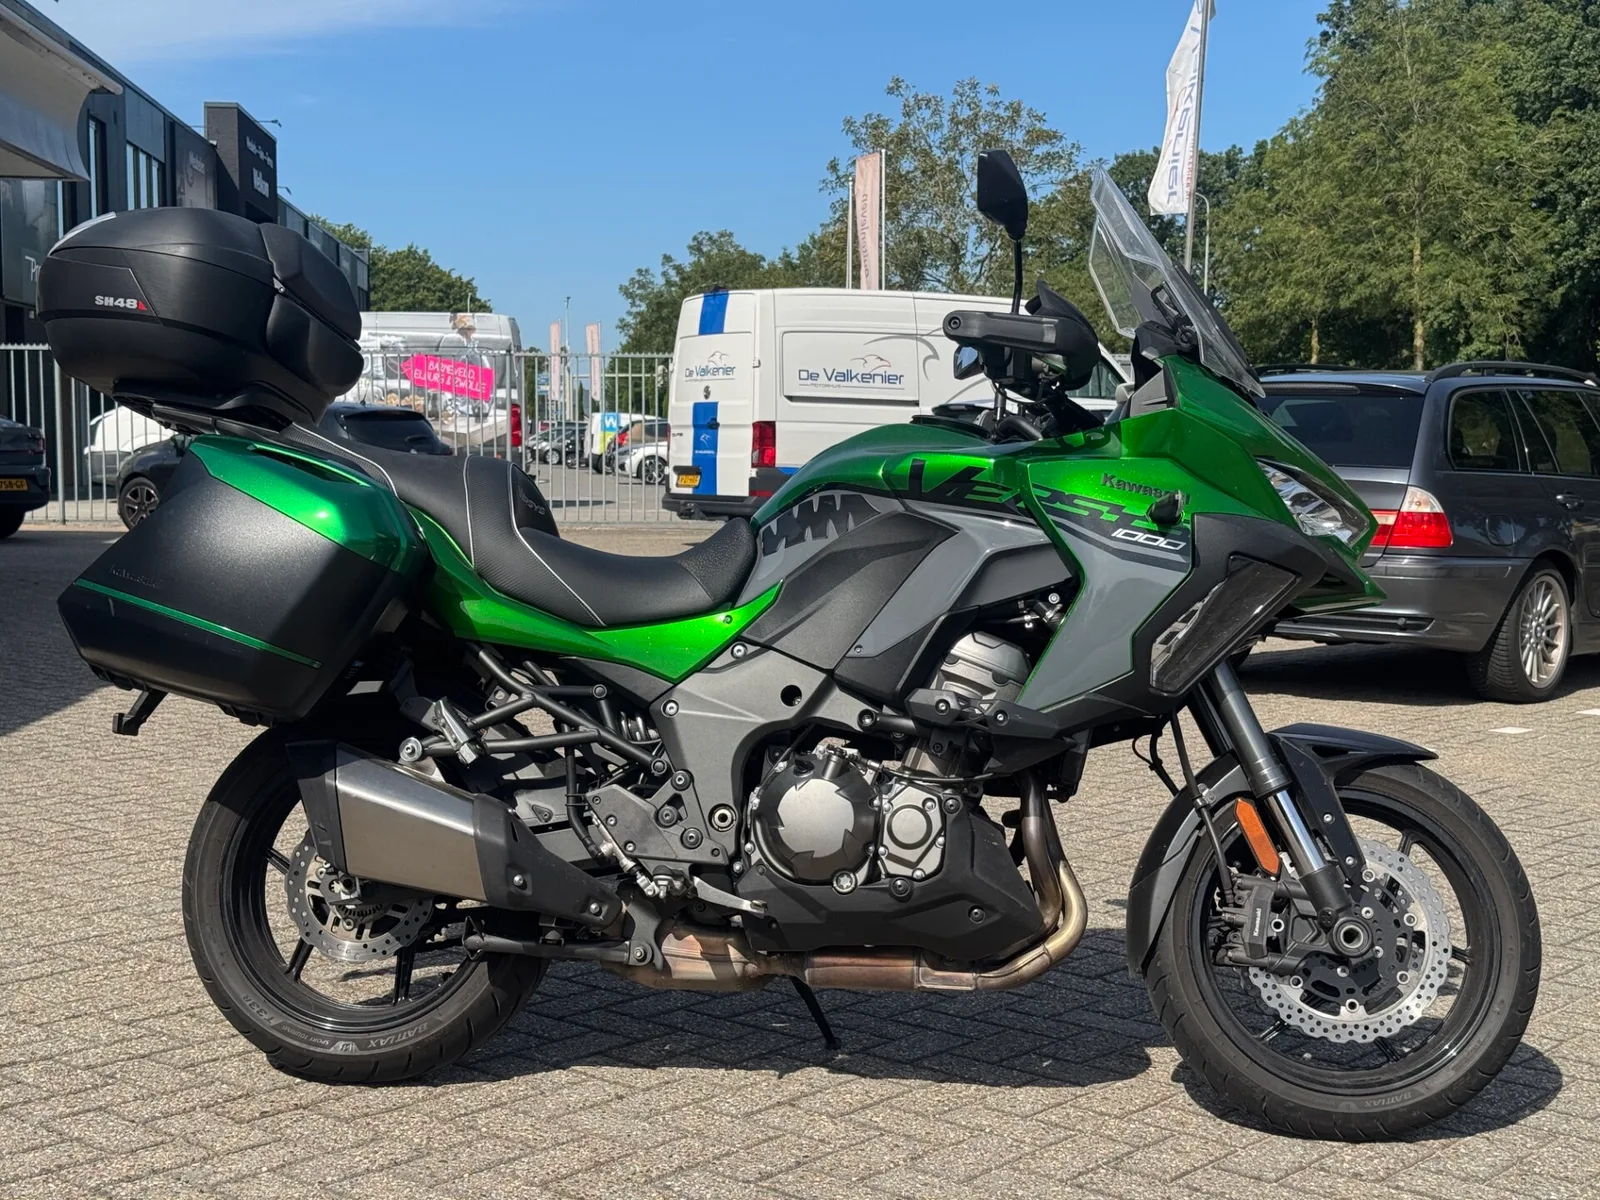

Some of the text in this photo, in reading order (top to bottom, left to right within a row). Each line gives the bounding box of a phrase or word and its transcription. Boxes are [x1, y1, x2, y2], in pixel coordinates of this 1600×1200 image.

[94, 295, 138, 309] SH48
[695, 364, 736, 377] Valkenier
[798, 368, 904, 385] De Valkenier
[1111, 527, 1187, 550] 1000
